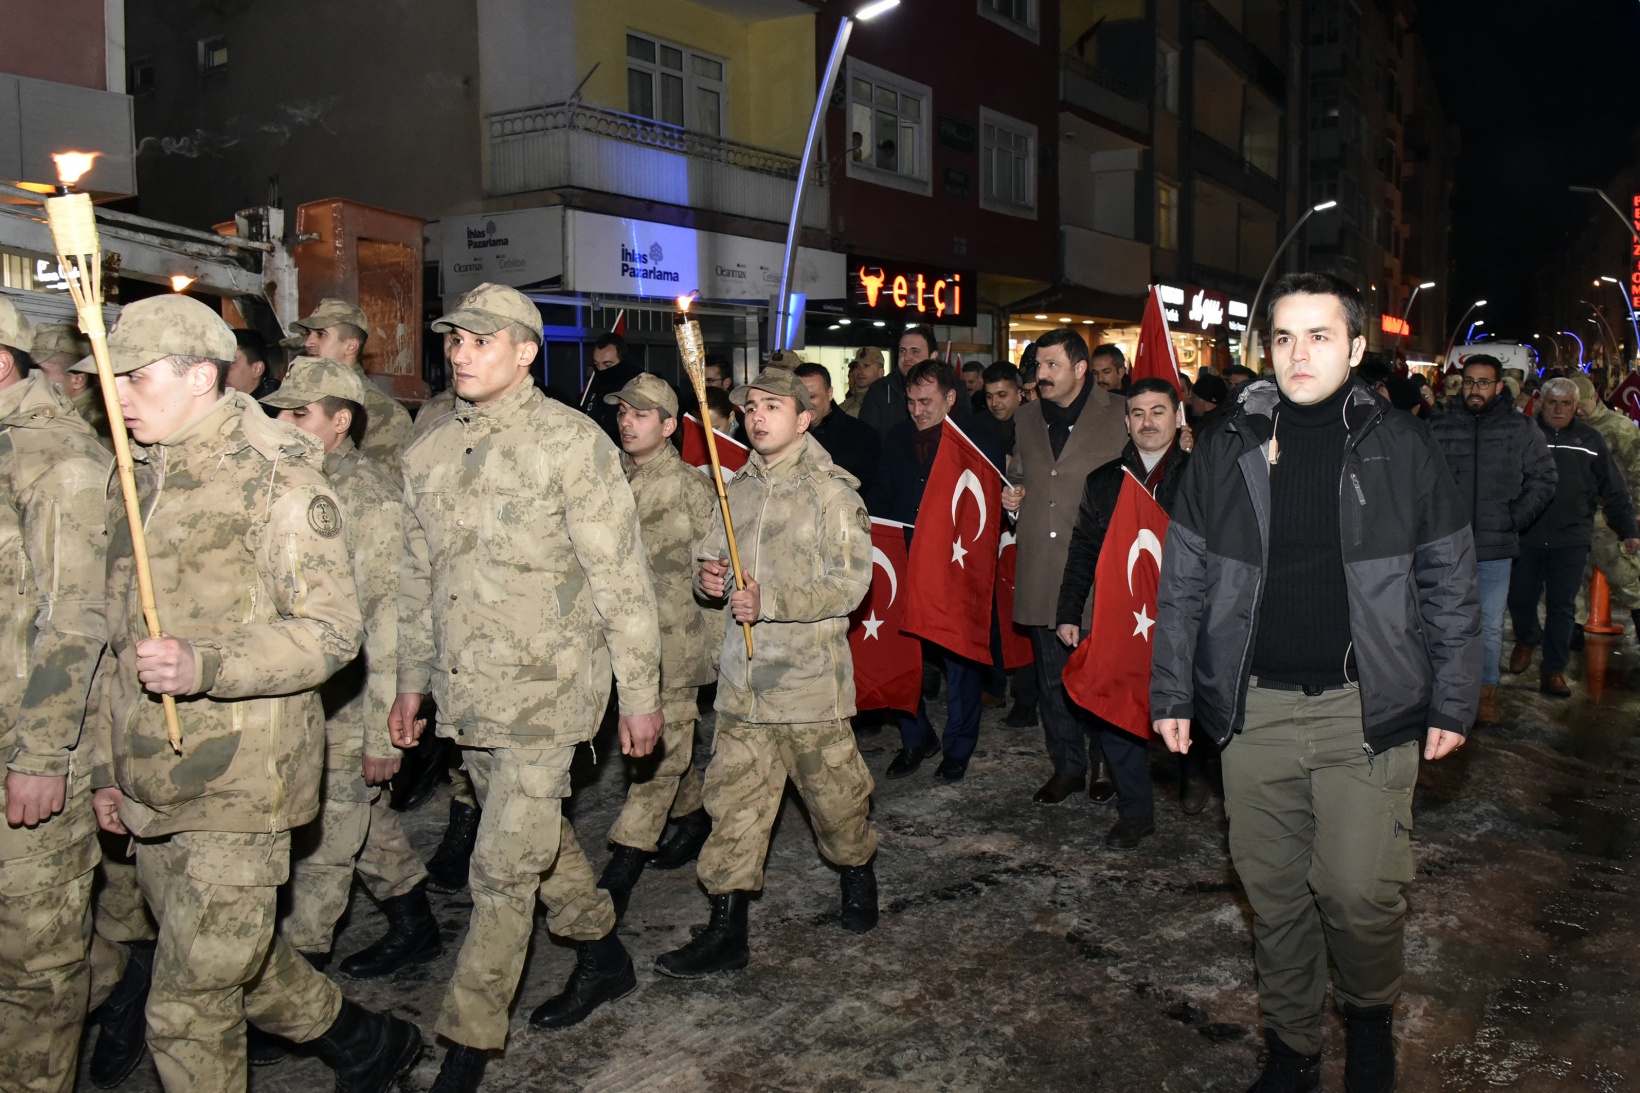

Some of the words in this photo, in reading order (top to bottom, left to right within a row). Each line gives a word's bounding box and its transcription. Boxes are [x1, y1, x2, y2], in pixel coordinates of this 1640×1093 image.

[466, 227, 486, 239] İhlas
[467, 238, 509, 249] Pazarlama
[621, 243, 648, 265] İhlas
[621, 262, 680, 282] Pazarlama
[892, 273, 961, 318] etçi
